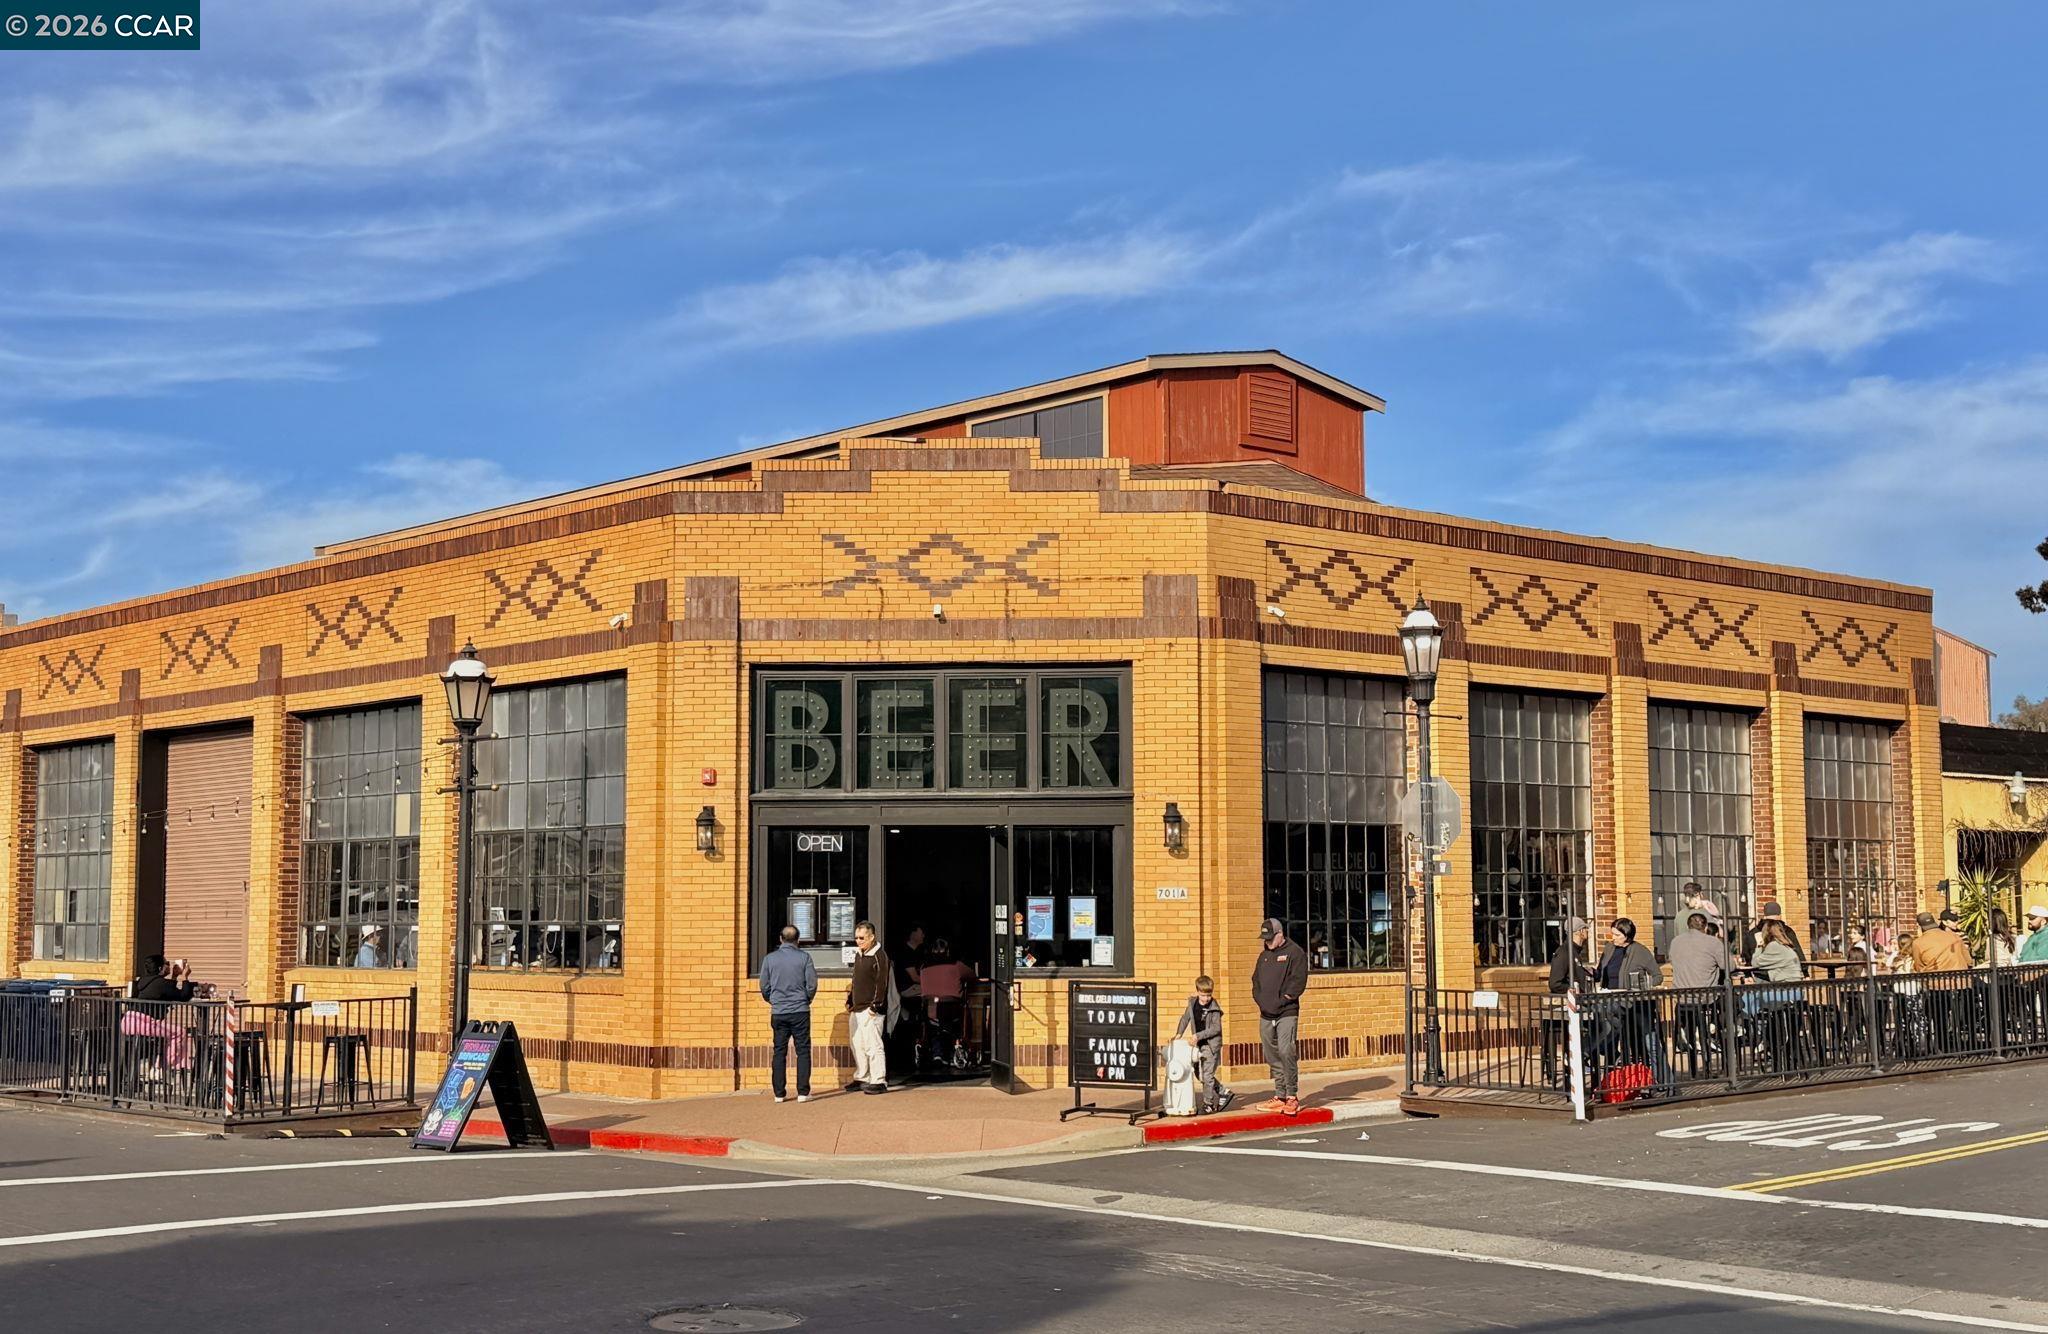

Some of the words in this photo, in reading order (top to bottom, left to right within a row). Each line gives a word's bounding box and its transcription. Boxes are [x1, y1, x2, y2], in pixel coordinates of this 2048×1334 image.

[774, 686, 1113, 788] BEER
[797, 834, 843, 852] OPEN
[1347, 851, 1376, 869] CIEO
[1313, 873, 1361, 890] BRWING
[1087, 1010, 1135, 1023] TODAY
[1088, 1038, 1139, 1052] FAMILY
[1094, 1053, 1137, 1066] BINGO
[1096, 1067, 1105, 1079] 4
[1108, 1067, 1125, 1079] PM
